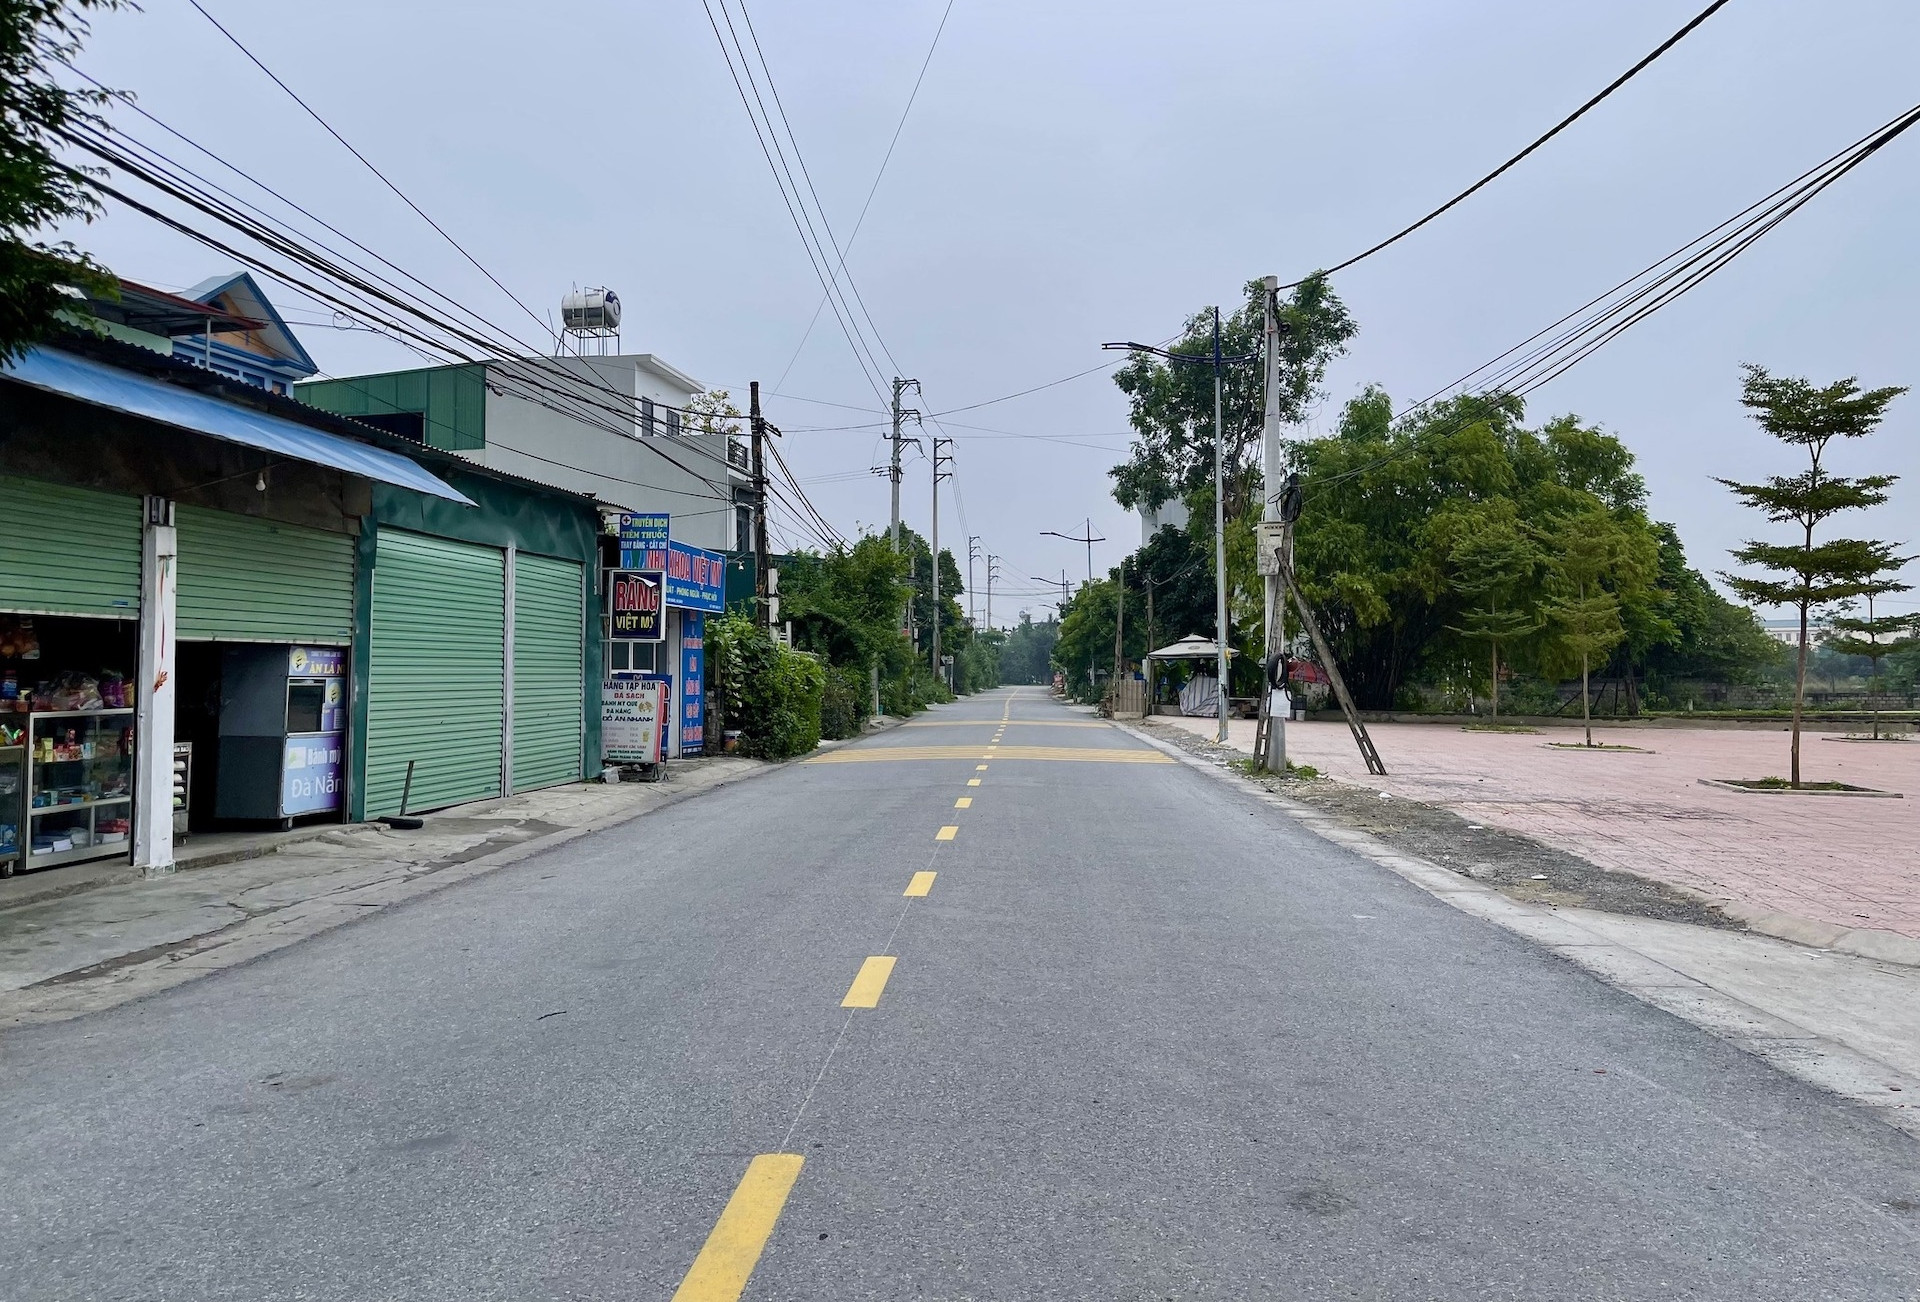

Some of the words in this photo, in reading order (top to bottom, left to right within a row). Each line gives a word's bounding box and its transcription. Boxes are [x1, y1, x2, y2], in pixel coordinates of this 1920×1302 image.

[641, 528, 668, 538] THUỐC
[668, 549, 691, 582] KHOA
[692, 552, 710, 590] VIỆT
[616, 574, 660, 612] RĂNG
[616, 612, 638, 630] VIỆT
[292, 777, 310, 798] Đà
[316, 772, 343, 794] Nẵn
